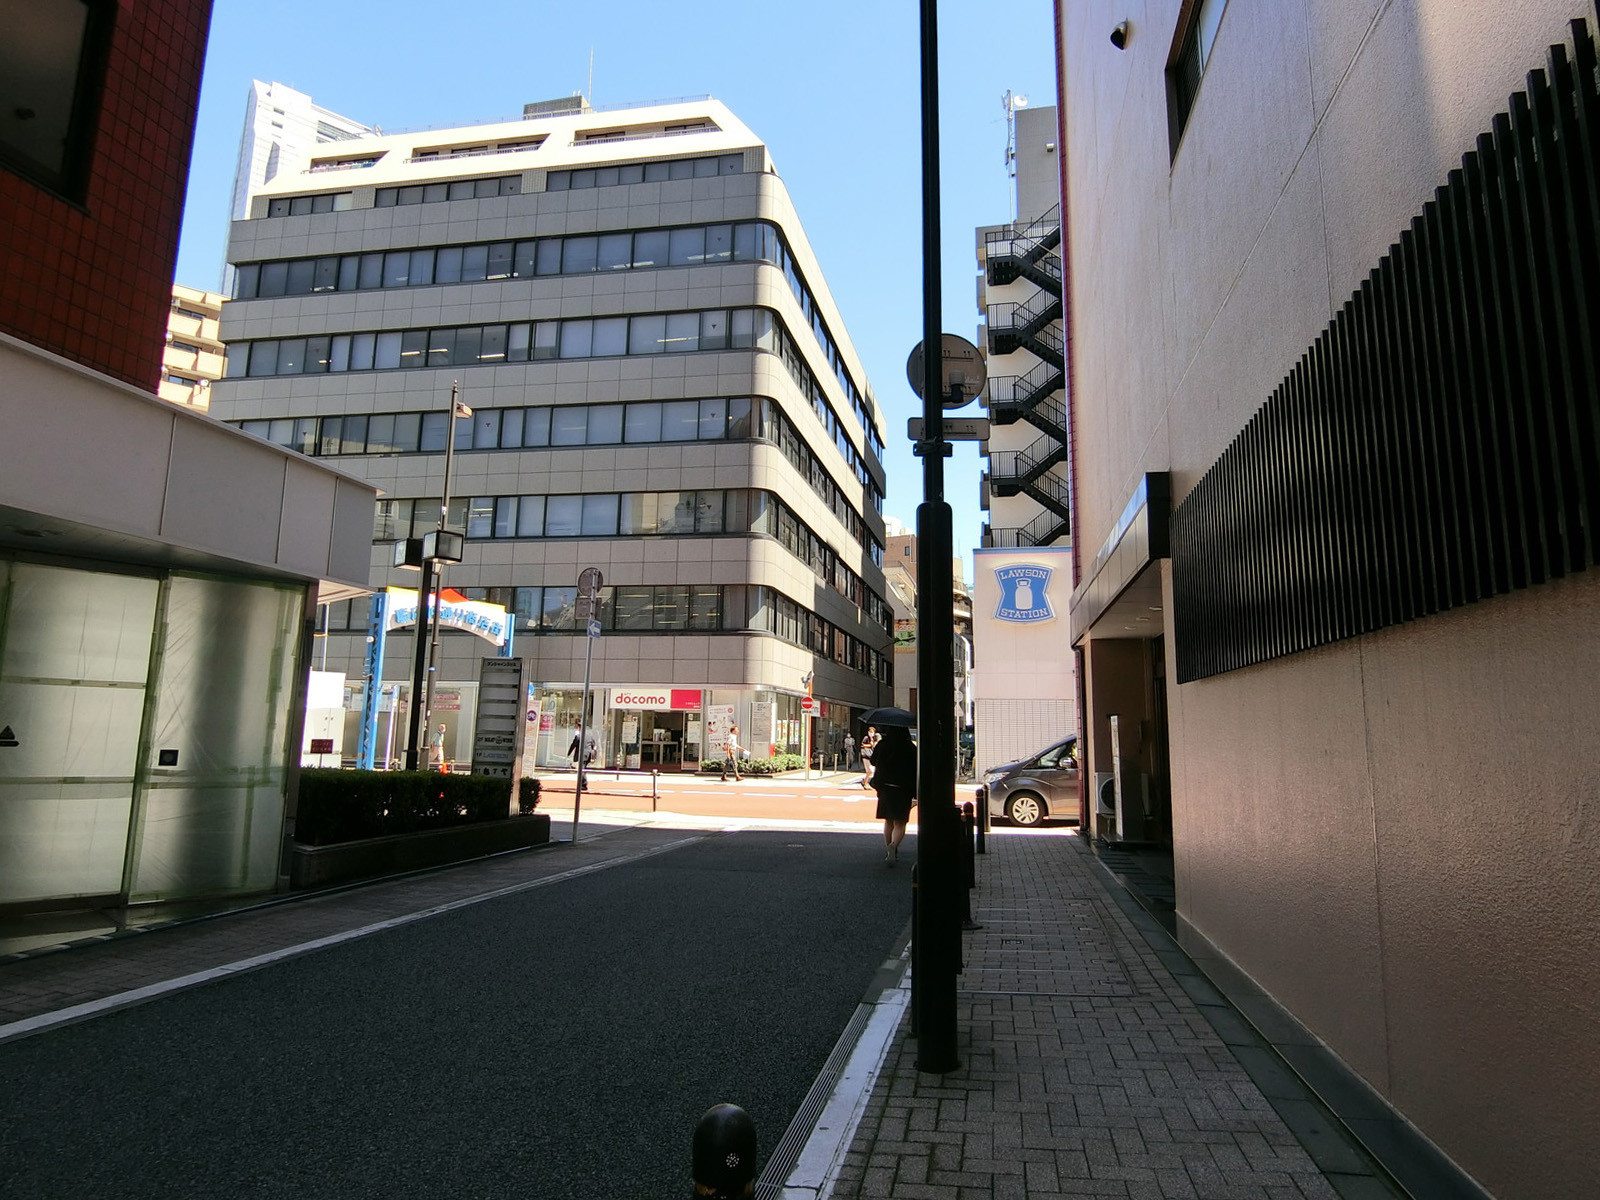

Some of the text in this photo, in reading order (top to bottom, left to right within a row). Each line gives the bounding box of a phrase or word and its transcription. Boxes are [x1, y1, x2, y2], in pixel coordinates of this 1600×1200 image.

[1000, 569, 1047, 580] LAWSON
[1000, 608, 1048, 619] STATION
[615, 693, 666, 704] docomo
